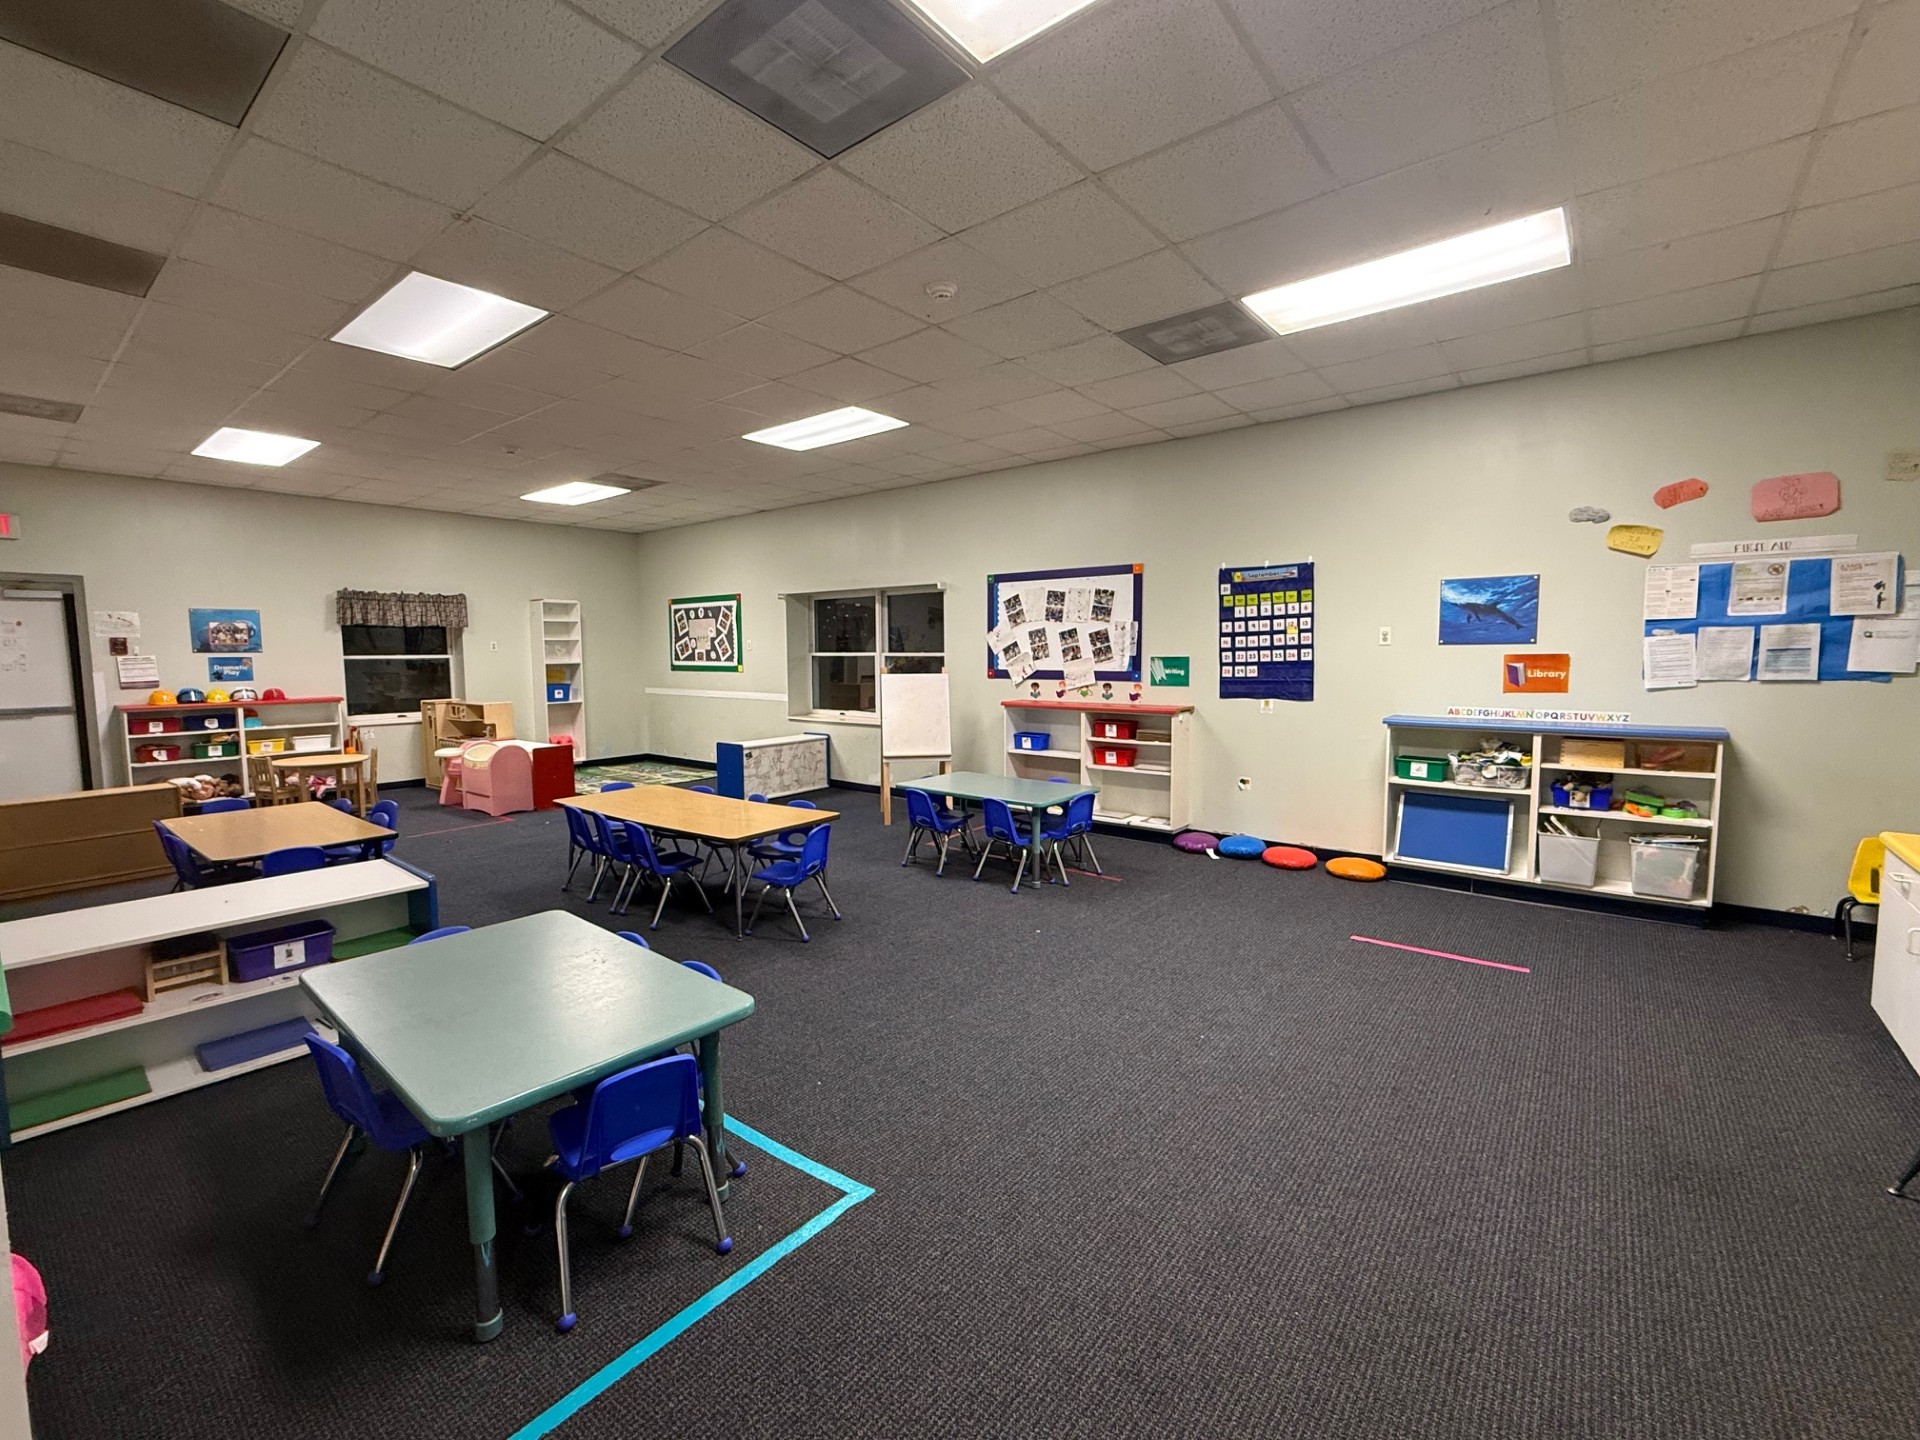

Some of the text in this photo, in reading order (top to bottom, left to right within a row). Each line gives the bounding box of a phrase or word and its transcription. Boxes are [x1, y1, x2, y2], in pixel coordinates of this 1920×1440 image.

[1734, 541, 1792, 553] FIRST AID
[1248, 570, 1280, 580] September
[1164, 668, 1185, 676] Writing
[1527, 669, 1566, 680] Library
